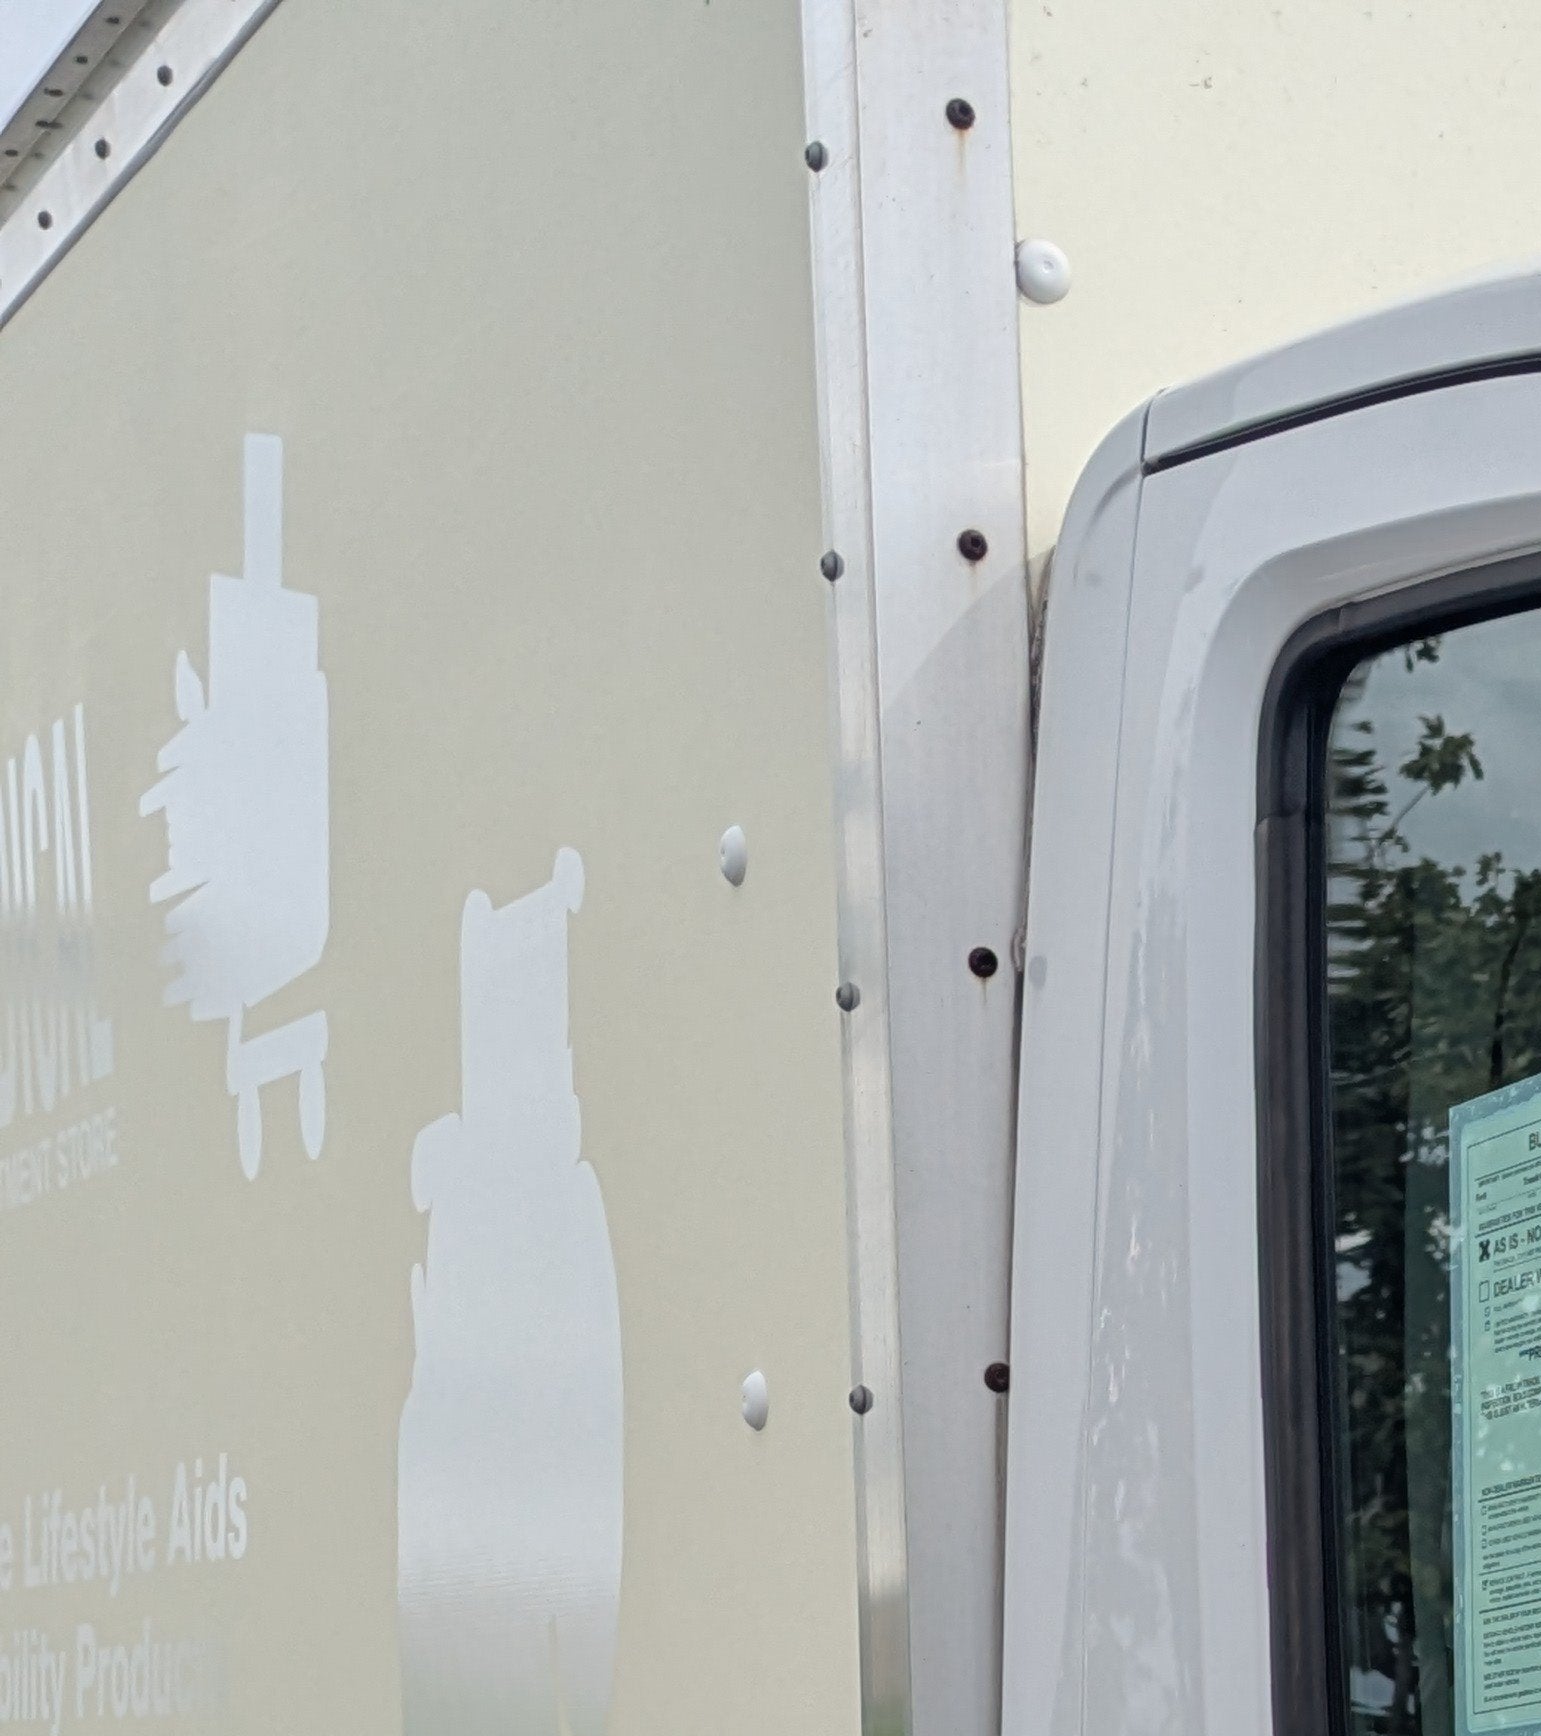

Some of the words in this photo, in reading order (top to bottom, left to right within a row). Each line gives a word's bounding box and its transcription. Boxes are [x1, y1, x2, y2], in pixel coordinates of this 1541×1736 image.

[1493, 1236, 1507, 1255] AS
[1509, 1232, 1519, 1249] IS
[1527, 1225, 1541, 1244] NO
[1494, 1271, 1534, 1298] DEALER
[22, 1473, 157, 1598] Lifestyle
[166, 1452, 249, 1563] Aids
